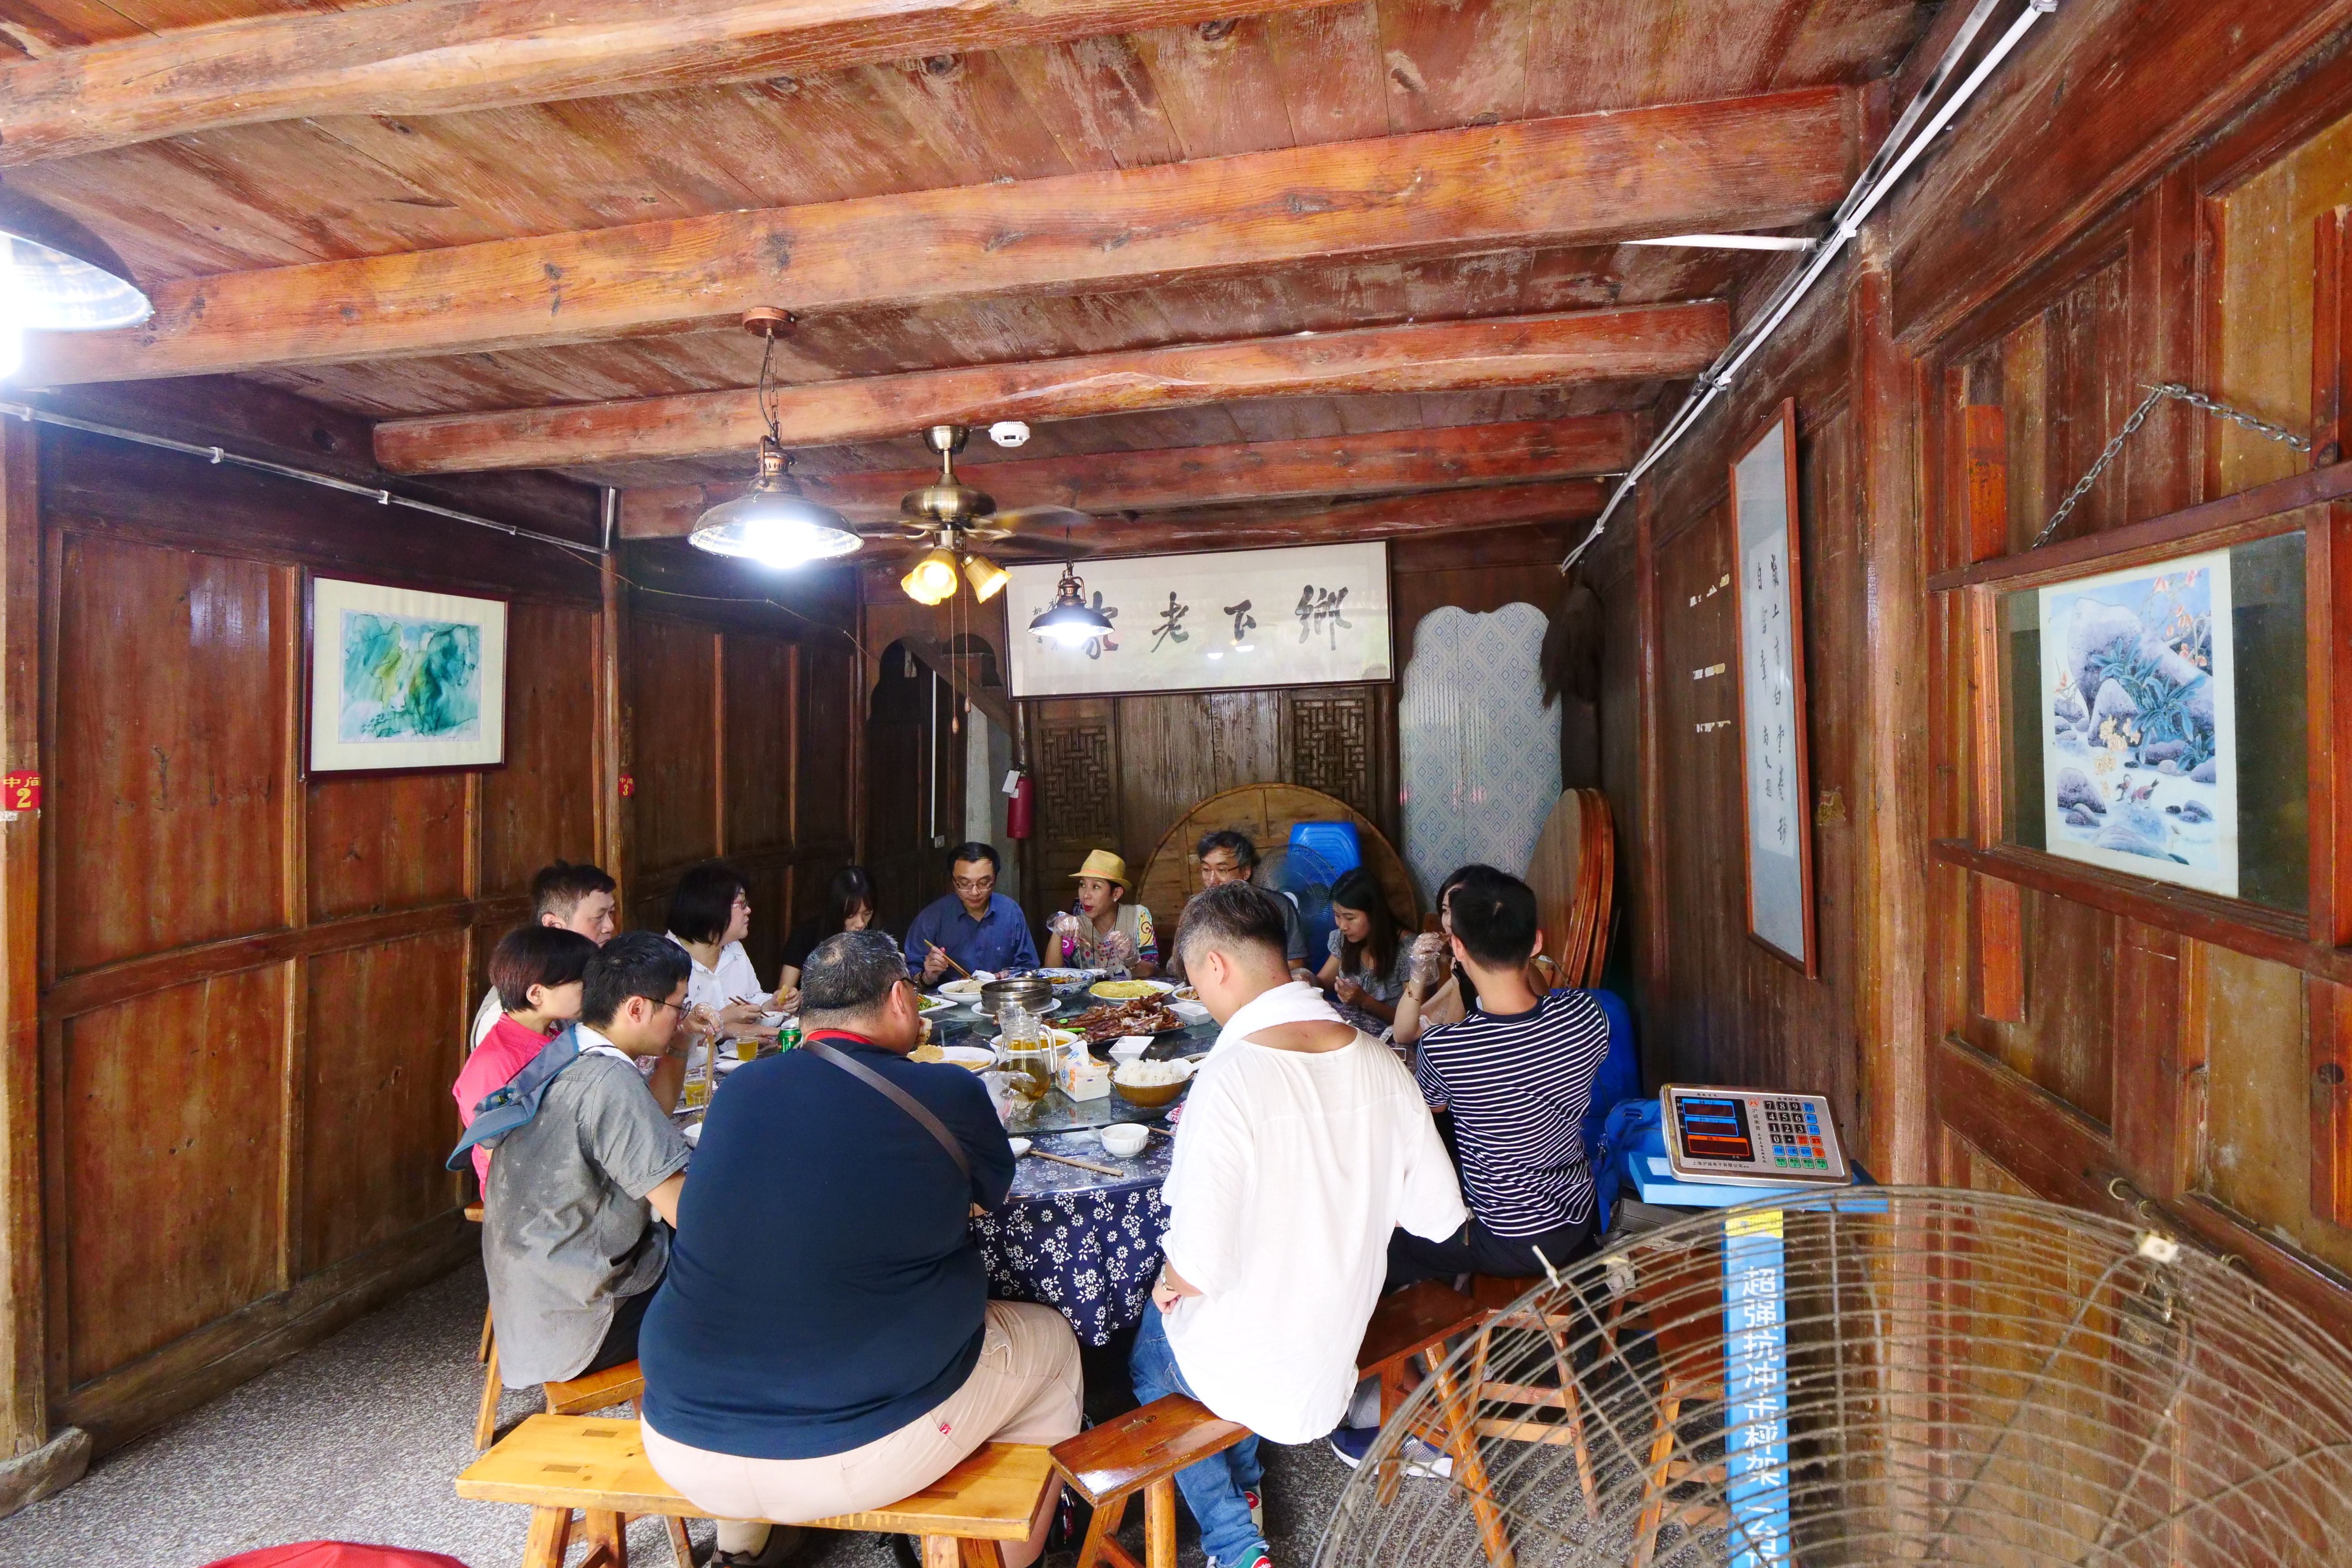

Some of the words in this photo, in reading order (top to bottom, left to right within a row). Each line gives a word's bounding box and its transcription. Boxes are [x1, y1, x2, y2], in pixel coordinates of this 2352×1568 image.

[3, 776, 41, 788] 中间
[623, 784, 628, 796] 3
[17, 788, 32, 808] 2
